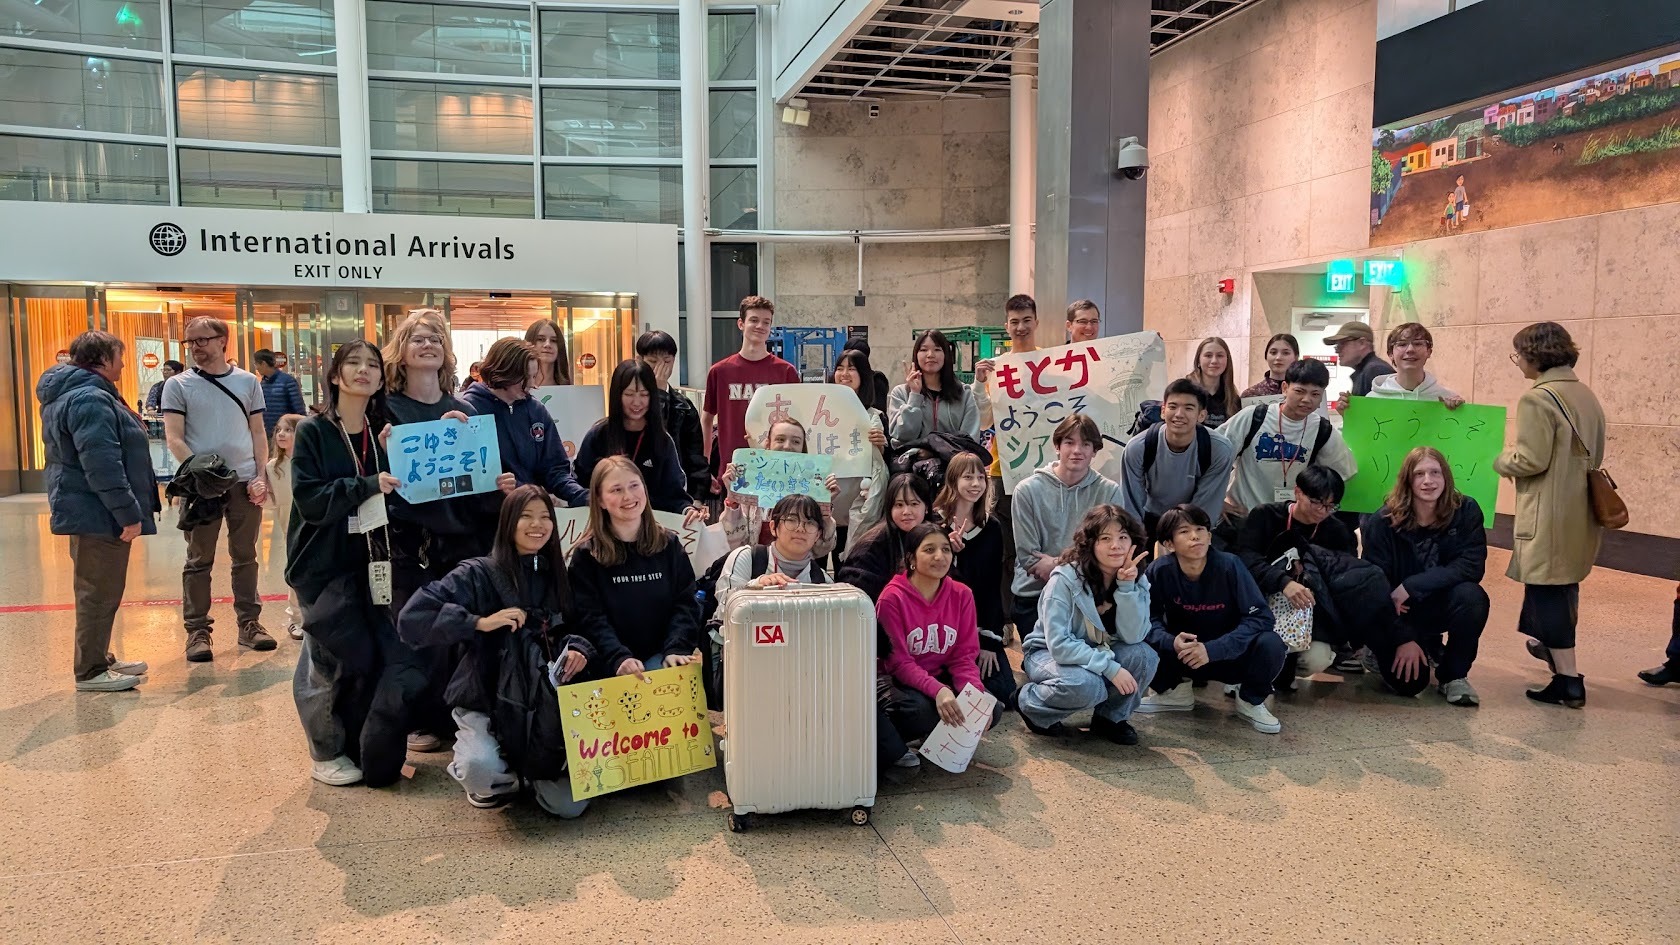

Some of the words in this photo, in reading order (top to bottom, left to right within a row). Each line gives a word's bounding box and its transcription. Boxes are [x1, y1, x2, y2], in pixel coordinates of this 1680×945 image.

[200, 228, 397, 257] International
[407, 235, 515, 260] Arrivals
[294, 264, 331, 278] EXIT
[338, 265, 383, 280] ONLY
[1331, 274, 1353, 291] EXIT
[1369, 262, 1394, 278] EXIT
[996, 346, 1101, 399] もとか
[766, 394, 839, 427] あん
[1000, 395, 1087, 431] ようこそ
[1373, 410, 1486, 440] ようこそ
[401, 427, 458, 454] こゆき
[1006, 435, 1051, 470] シア
[407, 446, 488, 483] ようこそ!
[612, 575, 630, 584] YOUR
[631, 574, 646, 582] TRUE
[648, 572, 663, 581] STEP
[906, 623, 958, 656] GAP
[579, 727, 672, 759] Welcome
[682, 722, 699, 739] to
[601, 739, 702, 788] SEATTLE
